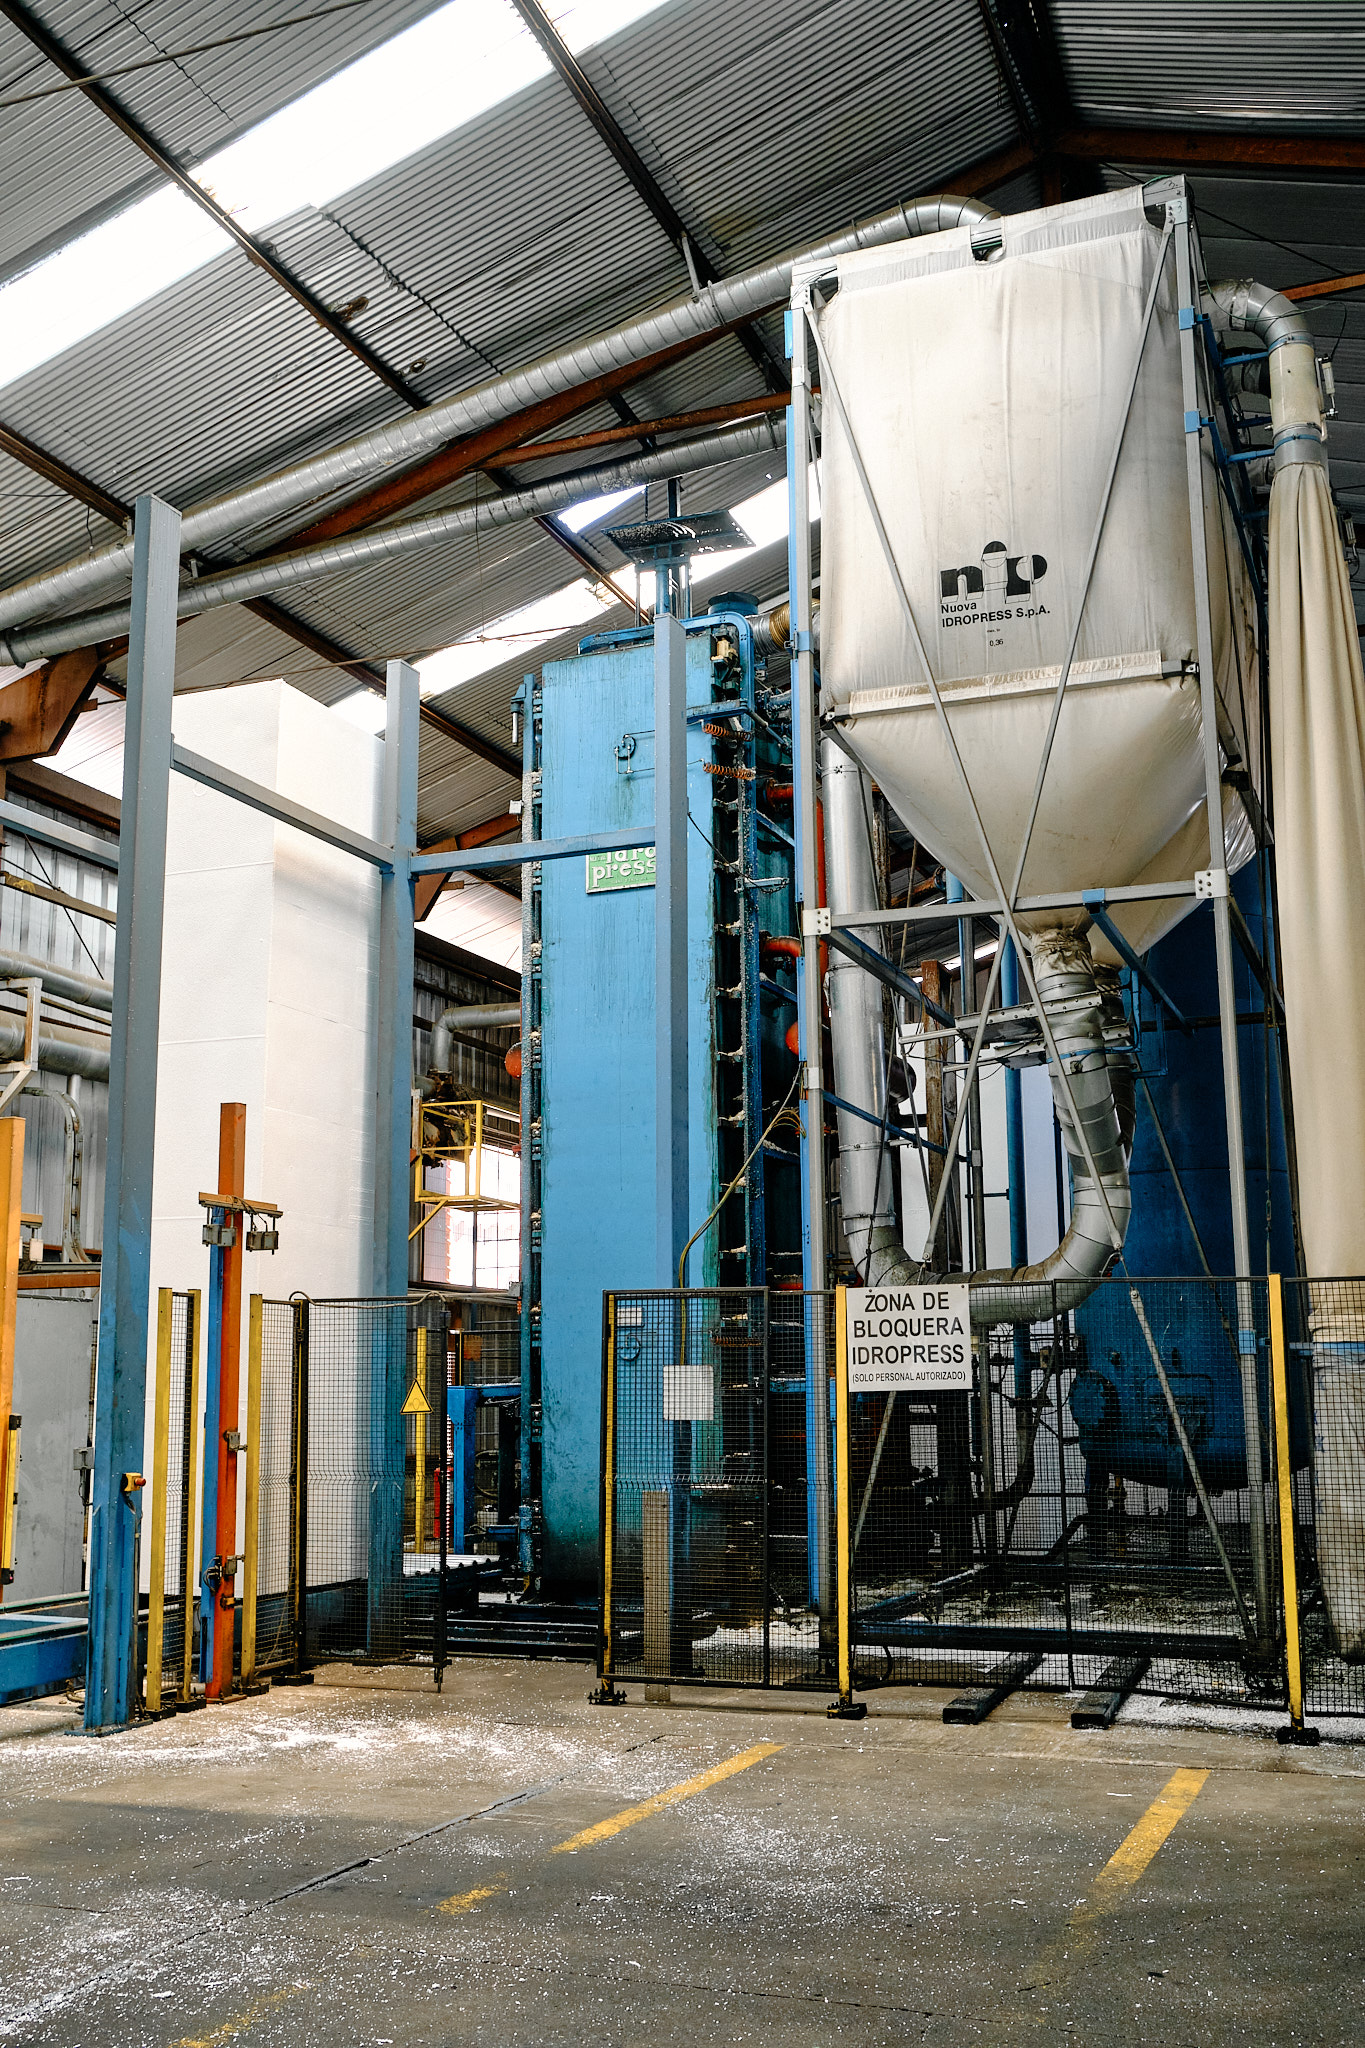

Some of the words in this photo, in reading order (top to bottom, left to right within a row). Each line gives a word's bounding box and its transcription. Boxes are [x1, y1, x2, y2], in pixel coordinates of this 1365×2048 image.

[941, 602, 977, 614] Nuova
[942, 609, 1013, 628] IDROPRESS
[1016, 605, 1051, 619] S.p.A.
[864, 1293, 915, 1313] ZONA
[923, 1291, 950, 1310] DE
[853, 1317, 964, 1339] BLOQUERA
[852, 1344, 965, 1365] IDROPRESS
[852, 1373, 874, 1384] (SOLO
[876, 1372, 914, 1382] PERSONAL
[915, 1371, 966, 1382] AUTORIZADO)
